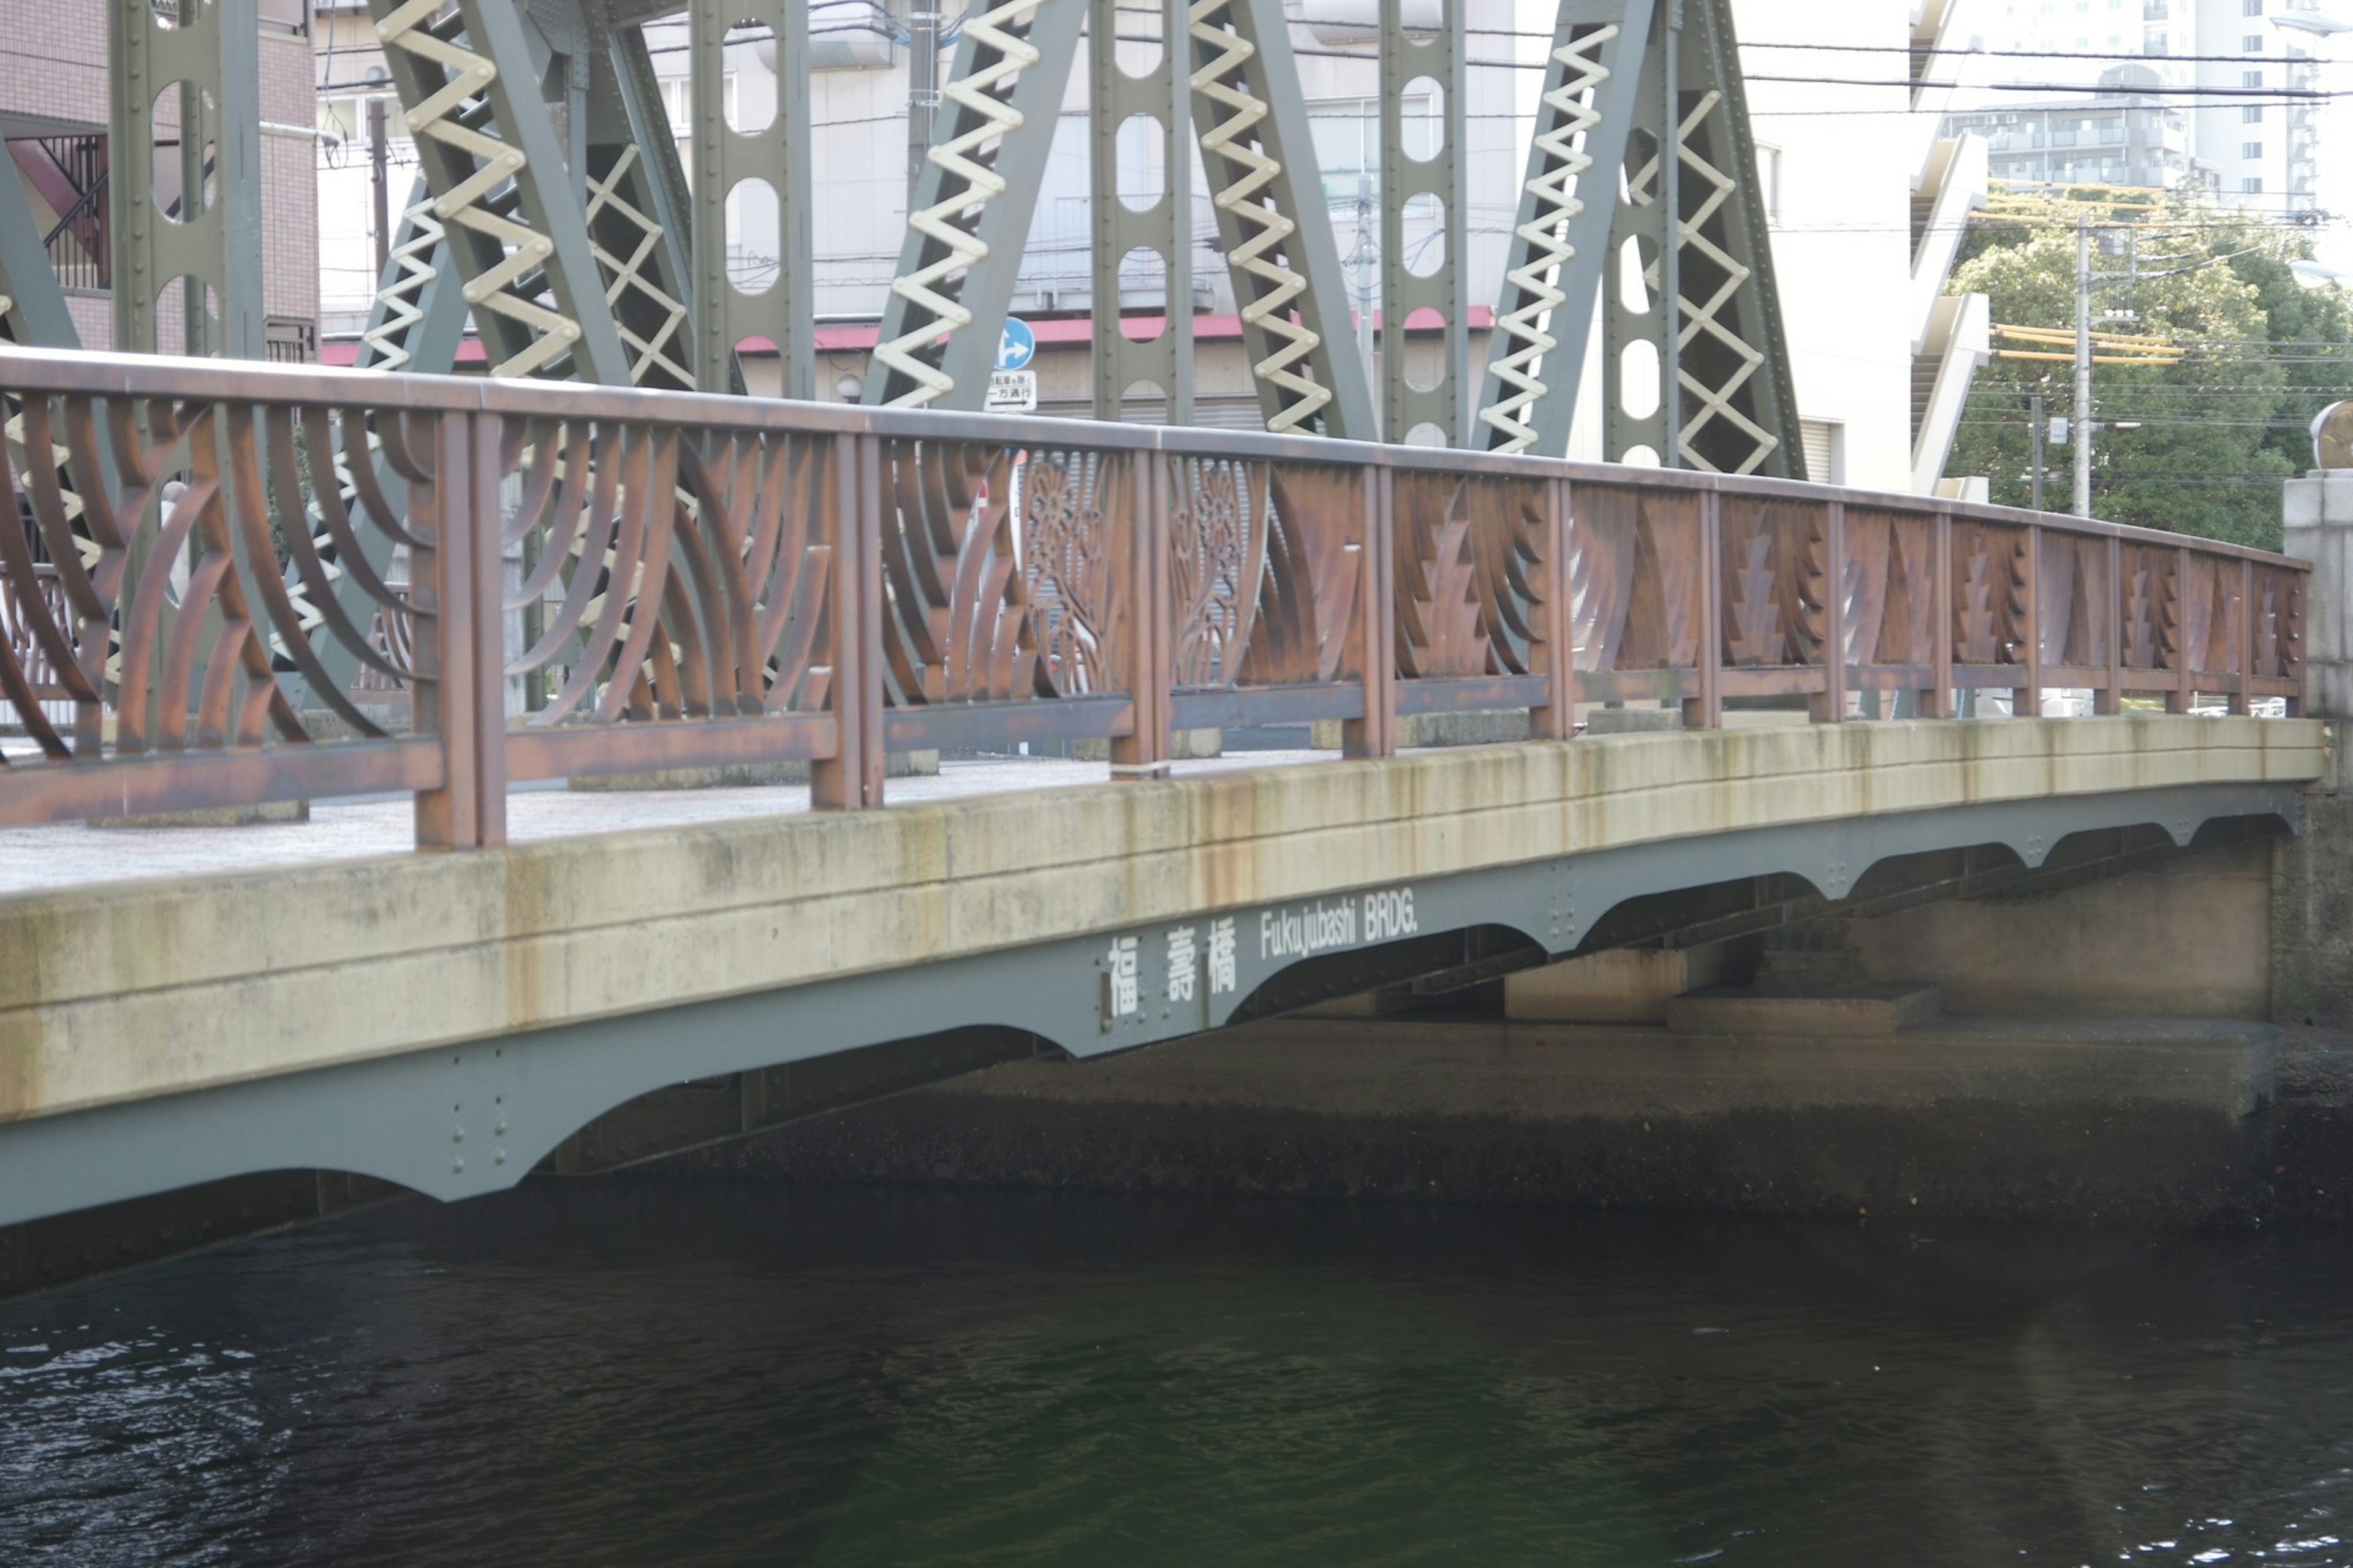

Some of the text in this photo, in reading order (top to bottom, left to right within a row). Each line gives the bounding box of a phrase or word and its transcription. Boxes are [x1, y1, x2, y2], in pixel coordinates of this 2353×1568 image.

[988, 387, 1031, 398] 一方通行
[1260, 896, 1355, 960] Fukujubashi
[1364, 887, 1418, 941] BRDG.
